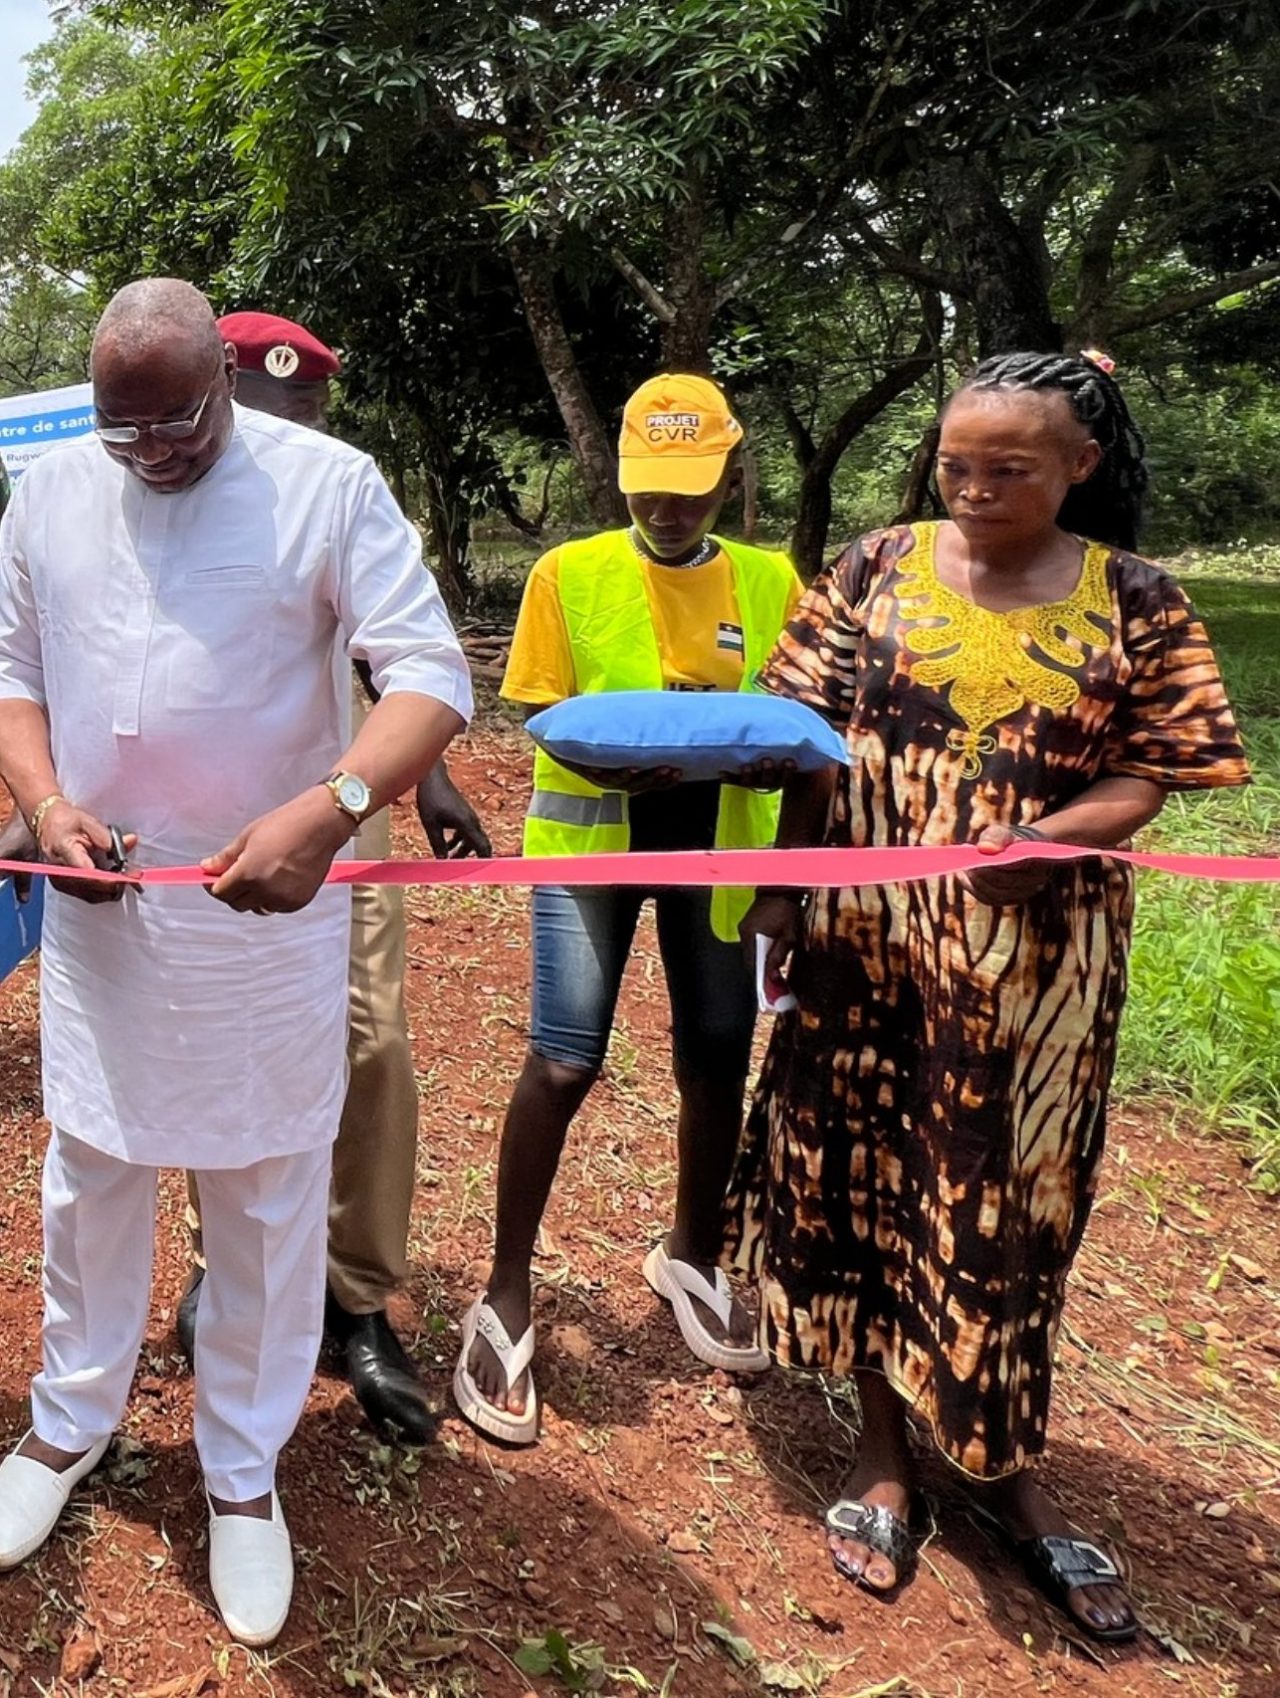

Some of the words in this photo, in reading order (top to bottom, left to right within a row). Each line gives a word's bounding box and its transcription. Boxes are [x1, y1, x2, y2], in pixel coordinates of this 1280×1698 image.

[32, 419, 55, 434] de
[647, 415, 698, 427] PROJET
[648, 428, 698, 442] CVR
